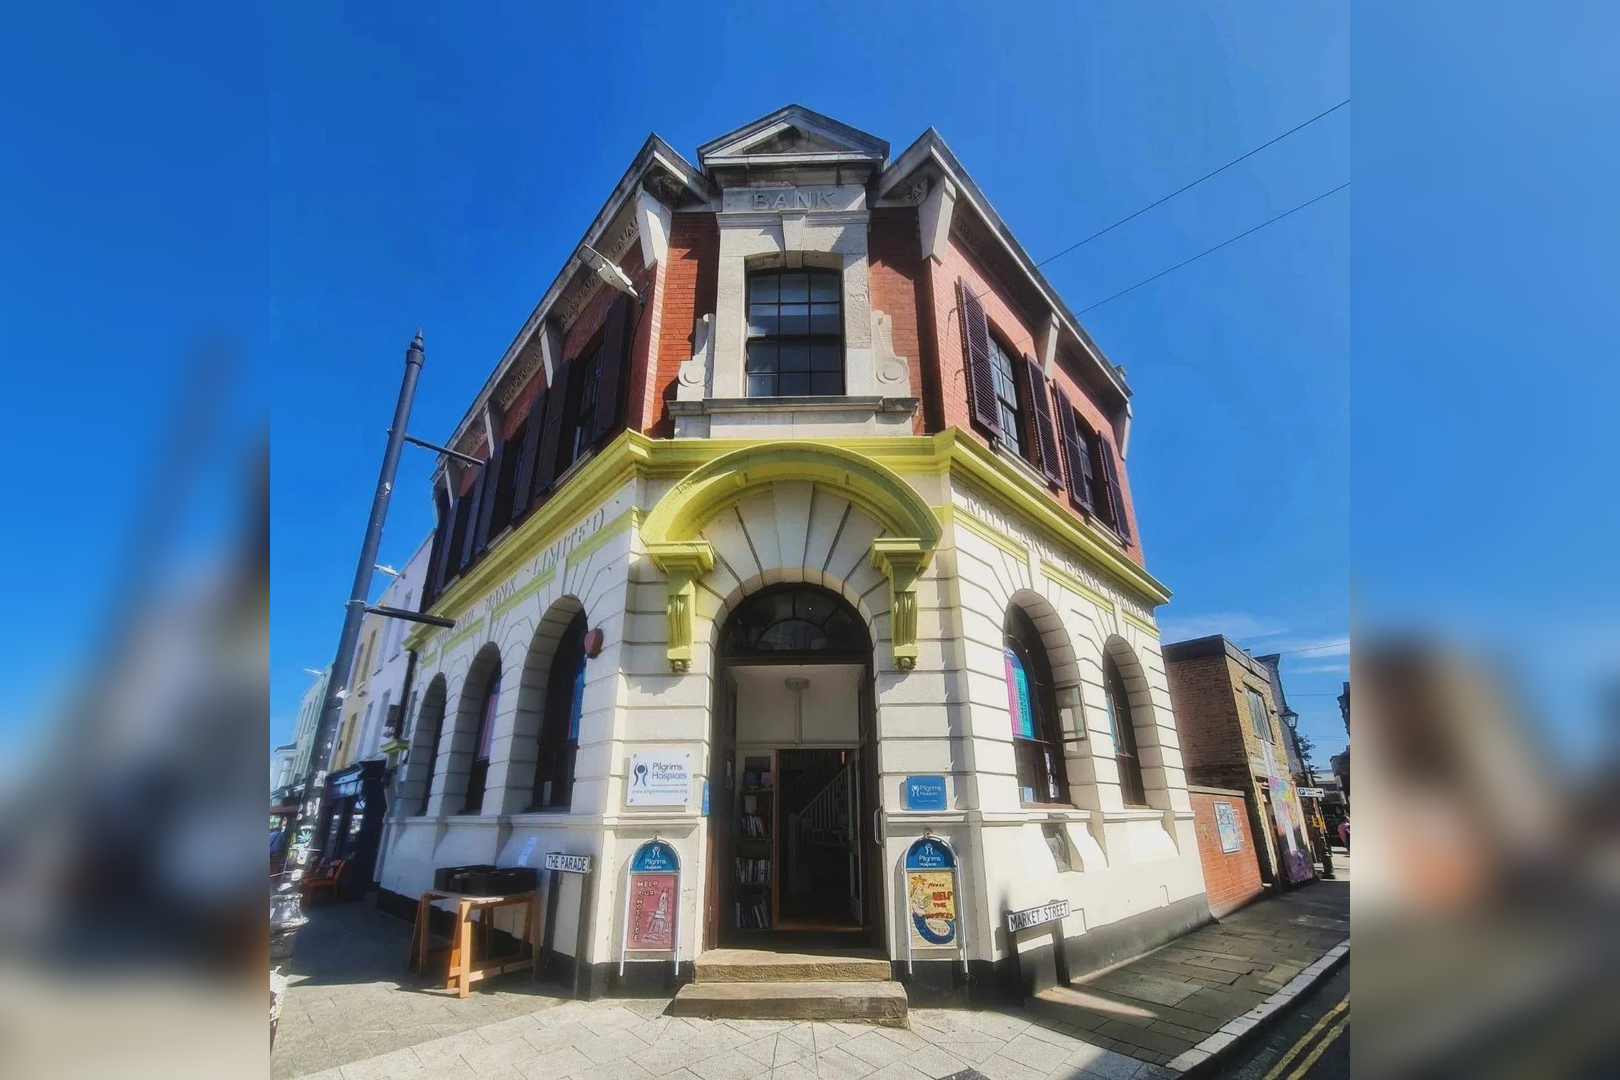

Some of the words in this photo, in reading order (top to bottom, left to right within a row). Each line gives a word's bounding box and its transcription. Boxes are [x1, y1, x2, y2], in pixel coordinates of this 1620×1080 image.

[752, 191, 835, 210] BANK
[533, 507, 604, 576] LIMITED
[652, 762, 683, 774] Pilgrims
[651, 771, 688, 781] Hospices
[920, 784, 942, 793] Pilgrims
[547, 855, 559, 868] THE
[560, 856, 586, 871] PARADE
[644, 858, 667, 867] Pilgrims
[918, 855, 942, 864] Pilgrims
[637, 880, 658, 889] HELP
[932, 891, 953, 901] HELP
[1010, 909, 1040, 931] MARKET
[1043, 902, 1067, 921] STREET
